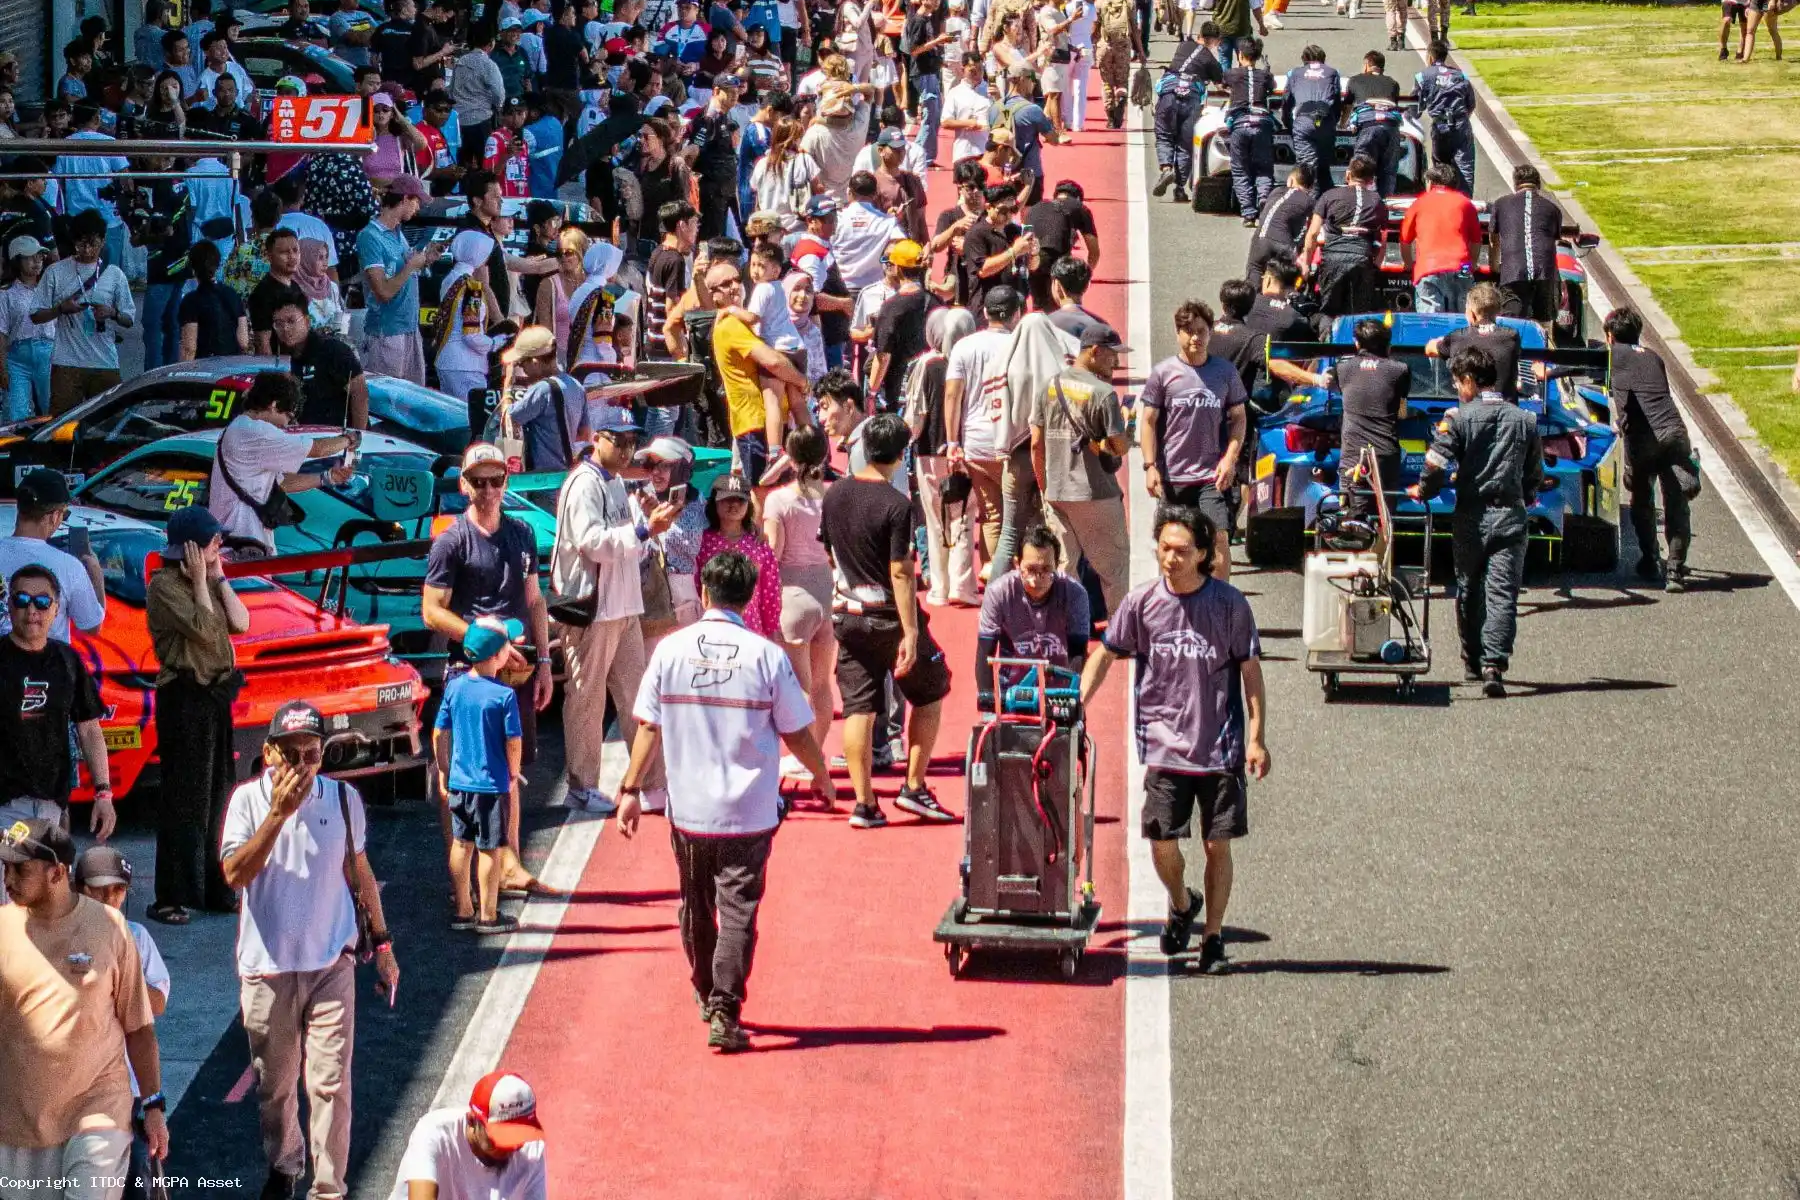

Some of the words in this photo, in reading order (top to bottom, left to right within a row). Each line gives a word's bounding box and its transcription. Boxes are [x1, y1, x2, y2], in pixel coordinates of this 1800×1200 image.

[300, 98, 362, 139] 51
[205, 389, 237, 420] 51
[163, 478, 199, 511] 25
[384, 474, 418, 494] aws
[378, 685, 412, 703] PRO-AM
